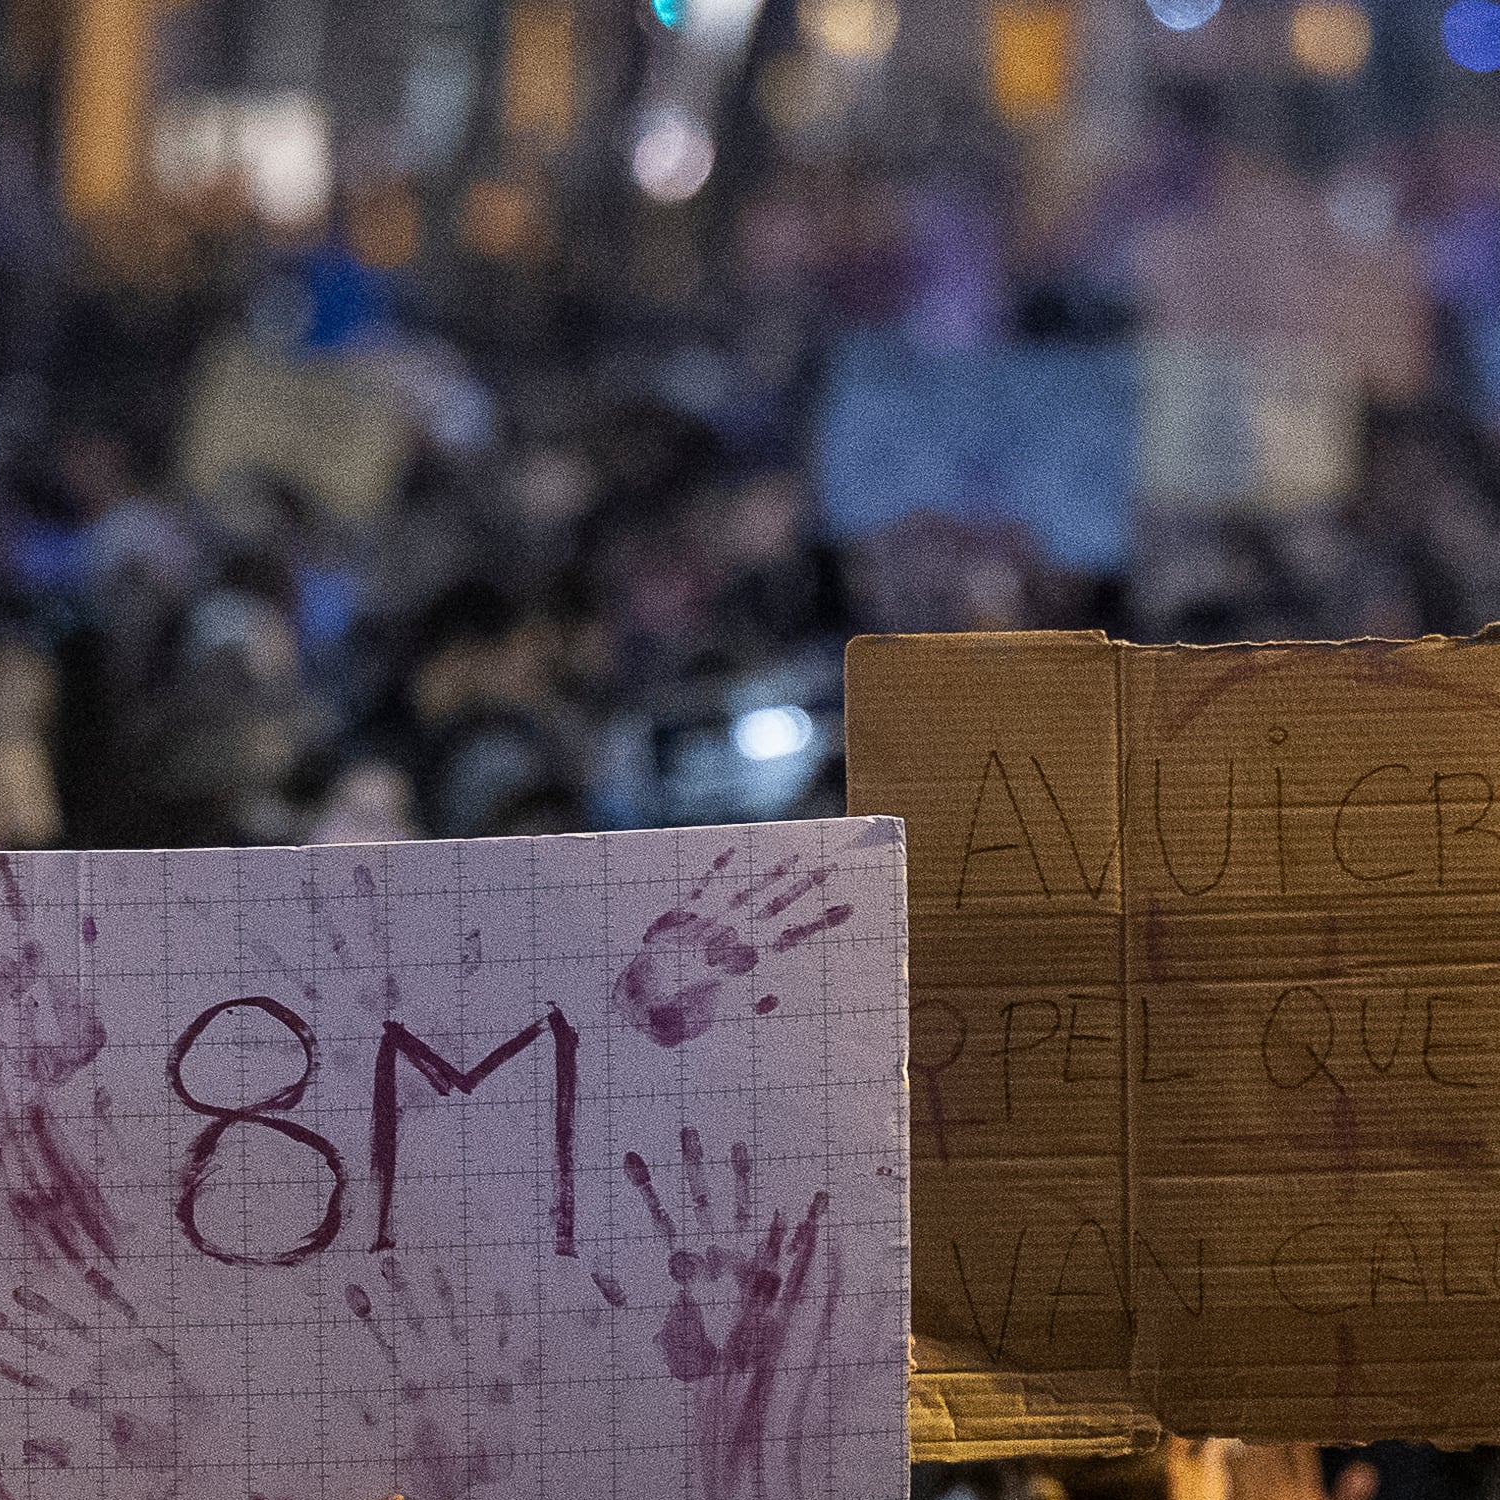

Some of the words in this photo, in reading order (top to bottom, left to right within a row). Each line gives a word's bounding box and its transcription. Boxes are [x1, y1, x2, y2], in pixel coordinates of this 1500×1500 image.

[990, 992, 1196, 1122] PEL
[1261, 984, 1488, 1097] QUE
[166, 994, 581, 1267] 8M
[951, 1218, 1206, 1365] VAN
